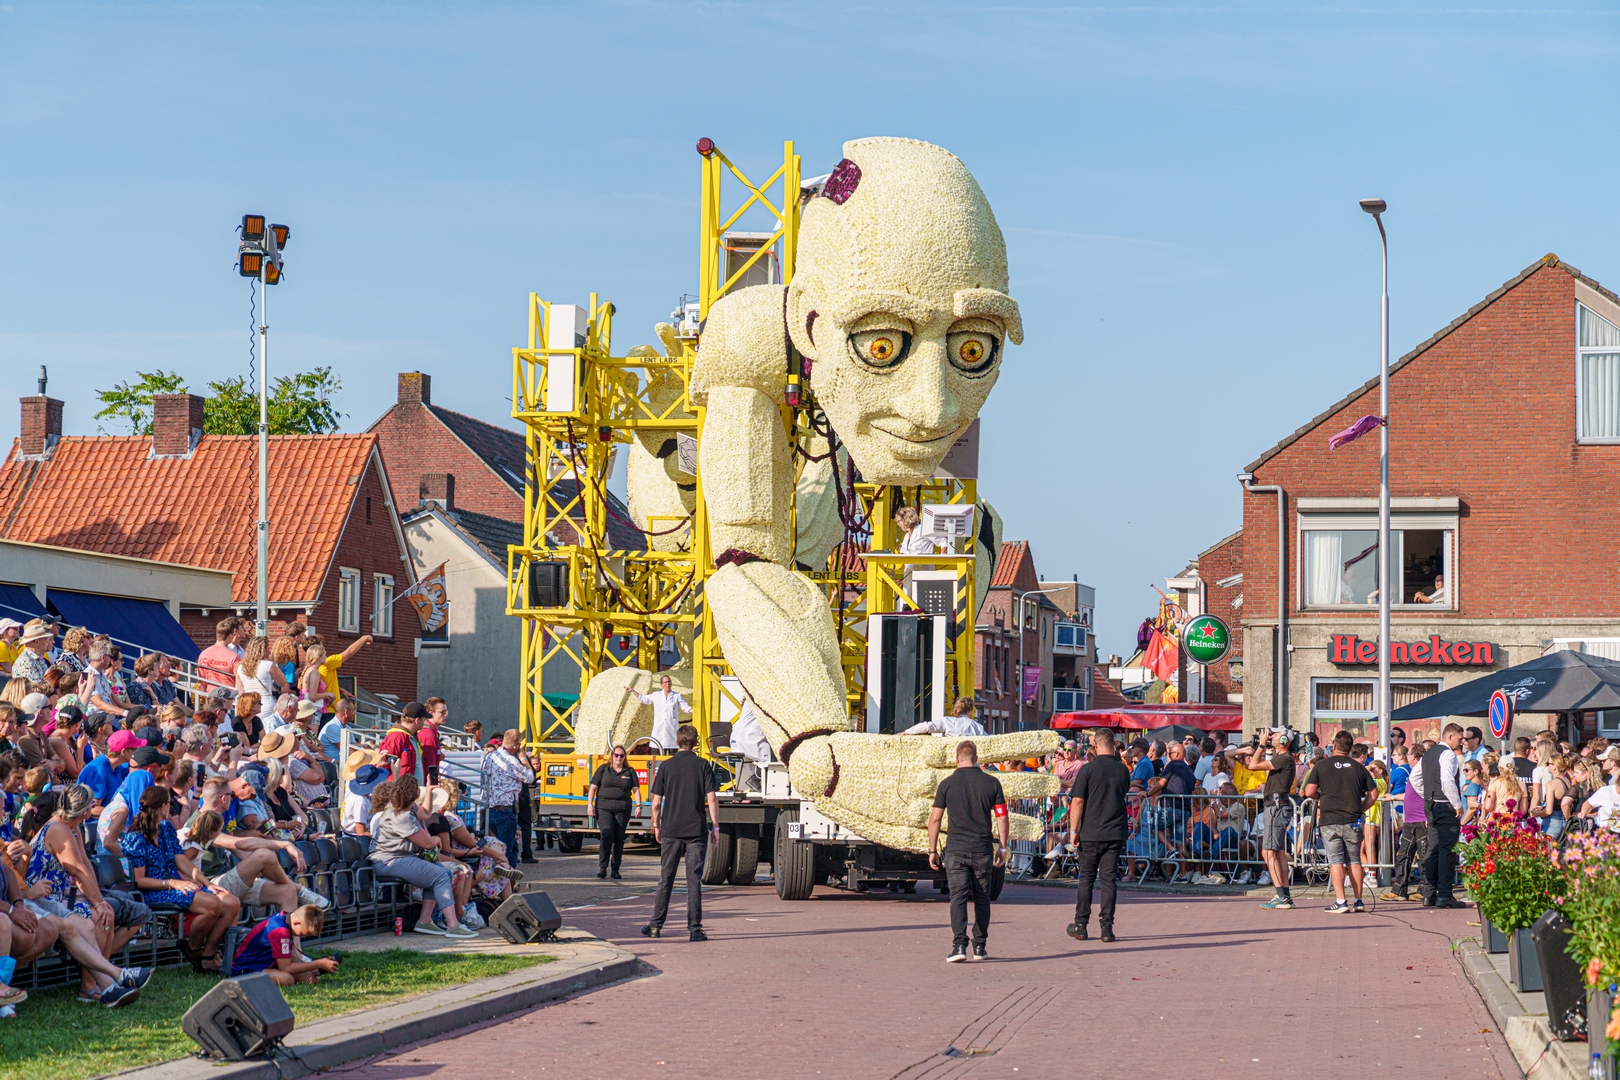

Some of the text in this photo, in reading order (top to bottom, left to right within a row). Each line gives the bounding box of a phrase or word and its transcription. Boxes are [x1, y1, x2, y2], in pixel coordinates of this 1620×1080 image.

[1189, 639, 1226, 649] Heineken
[1331, 634, 1494, 664] Heneken
[790, 824, 799, 832] 03
